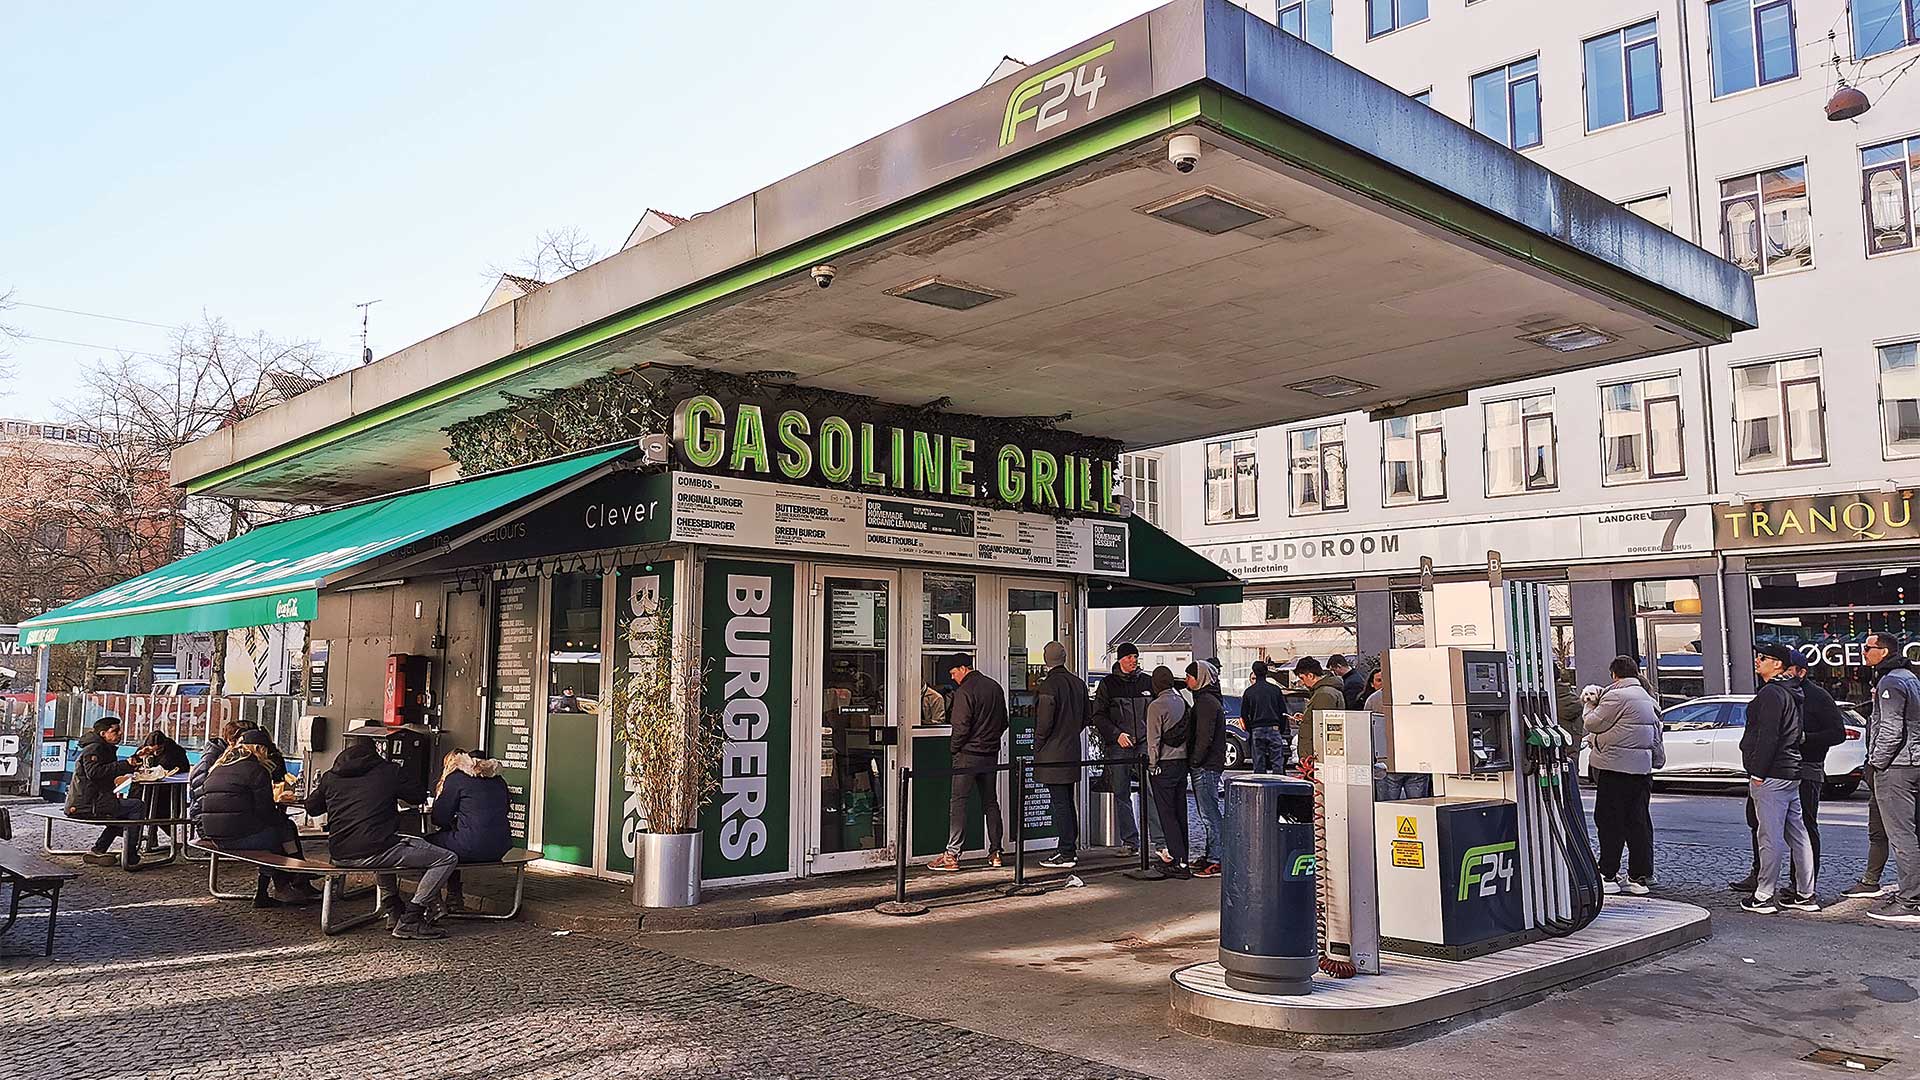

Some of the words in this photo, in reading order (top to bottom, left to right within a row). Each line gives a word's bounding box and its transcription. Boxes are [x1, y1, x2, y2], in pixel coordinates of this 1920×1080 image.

[998, 39, 1116, 148] F24
[684, 395, 977, 498] GASOLINE
[998, 443, 1118, 515] GRILL
[677, 477, 713, 489] COMBOS
[677, 493, 713, 505] ORIGINAL
[713, 497, 744, 508] BURGER
[867, 502, 881, 510] OUR
[585, 500, 658, 529] Clever
[867, 510, 904, 520] HOMEMADE
[1724, 499, 1912, 540] TRANQU
[676, 517, 736, 531] CHEESEBURGER
[867, 518, 895, 528] ORGANIC
[895, 520, 928, 530] LEMONADE
[1651, 509, 1687, 552] 7
[775, 526, 799, 536] GREEN
[799, 527, 826, 539] BURGER
[867, 535, 892, 545] DOUBLE
[892, 536, 919, 547] TROUBLE
[978, 544, 1003, 554] ORGANIC
[1002, 546, 1032, 557] SPARKLING
[978, 552, 993, 560] WINE
[1201, 534, 1400, 565] KALEJDOROOM
[1033, 556, 1052, 564] BOTTLE
[1490, 559, 1499, 571] B
[1232, 567, 1243, 576] og
[1244, 564, 1289, 574] Indretning
[1422, 564, 1432, 576] A
[719, 573, 773, 861] BURGERS
[1291, 854, 1316, 876] F2
[1458, 840, 1516, 901] F24
